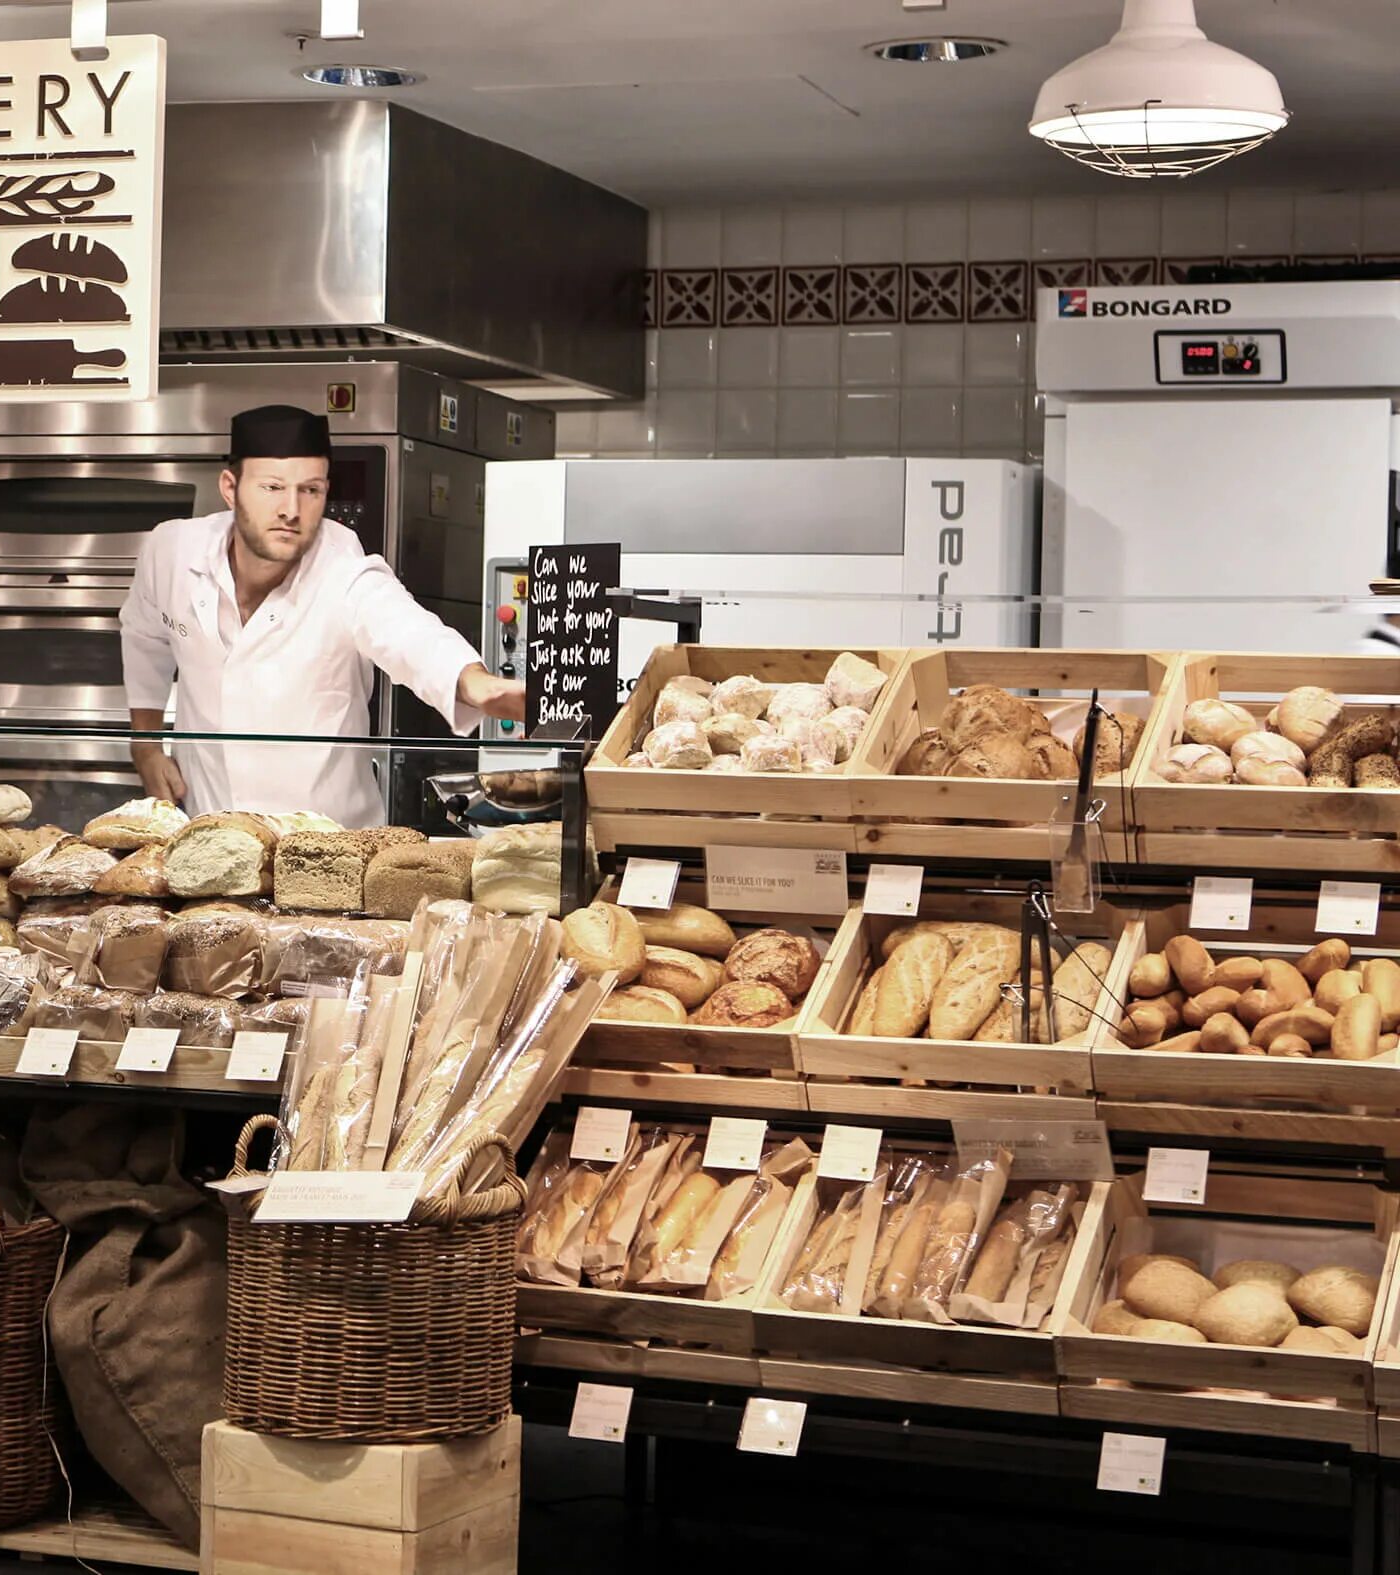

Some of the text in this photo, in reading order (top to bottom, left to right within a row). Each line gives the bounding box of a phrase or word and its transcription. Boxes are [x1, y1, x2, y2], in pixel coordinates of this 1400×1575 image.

[1091, 298, 1232, 318] BONGARD
[535, 548, 586, 578] Can we
[567, 580, 600, 609] your
[538, 608, 612, 643] loaf for you?
[530, 640, 610, 671] Just ask one
[544, 669, 587, 694] of our
[538, 696, 585, 725] Bakers
